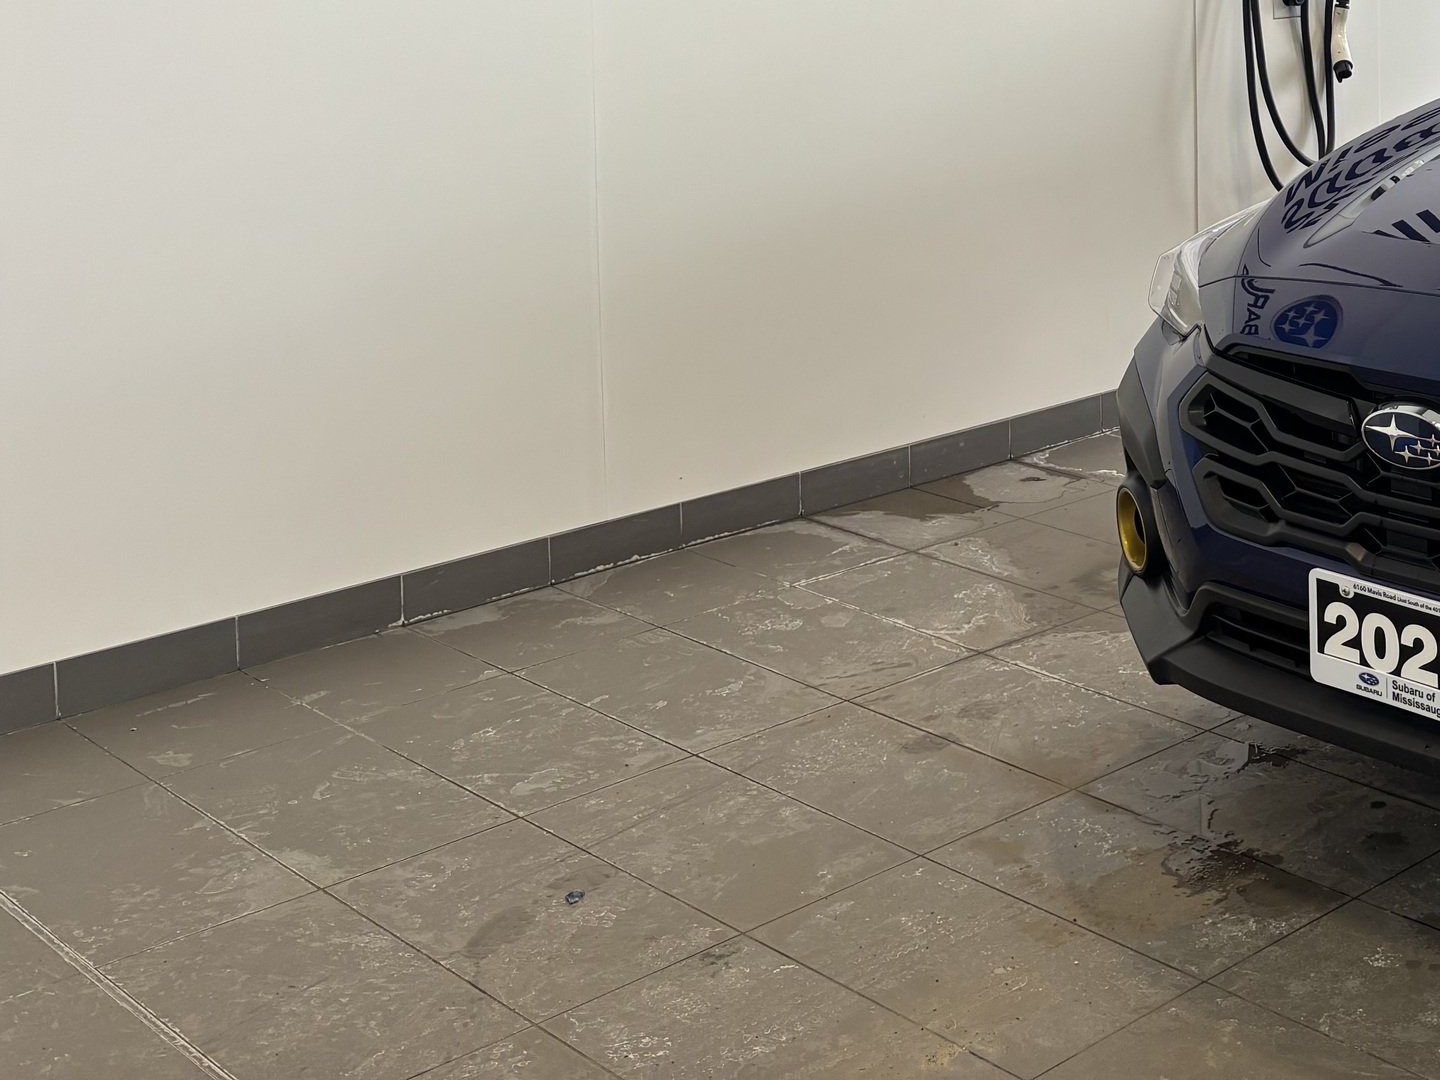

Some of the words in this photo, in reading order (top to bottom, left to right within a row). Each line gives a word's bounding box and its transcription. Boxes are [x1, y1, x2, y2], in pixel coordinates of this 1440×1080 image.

[1353, 583, 1366, 592] 6160
[1367, 587, 1382, 597] Mavis
[1382, 591, 1397, 601] Road
[1356, 683, 1383, 697] SUBARU
[1392, 679, 1424, 698] Subaru
[1426, 692, 1436, 702] of
